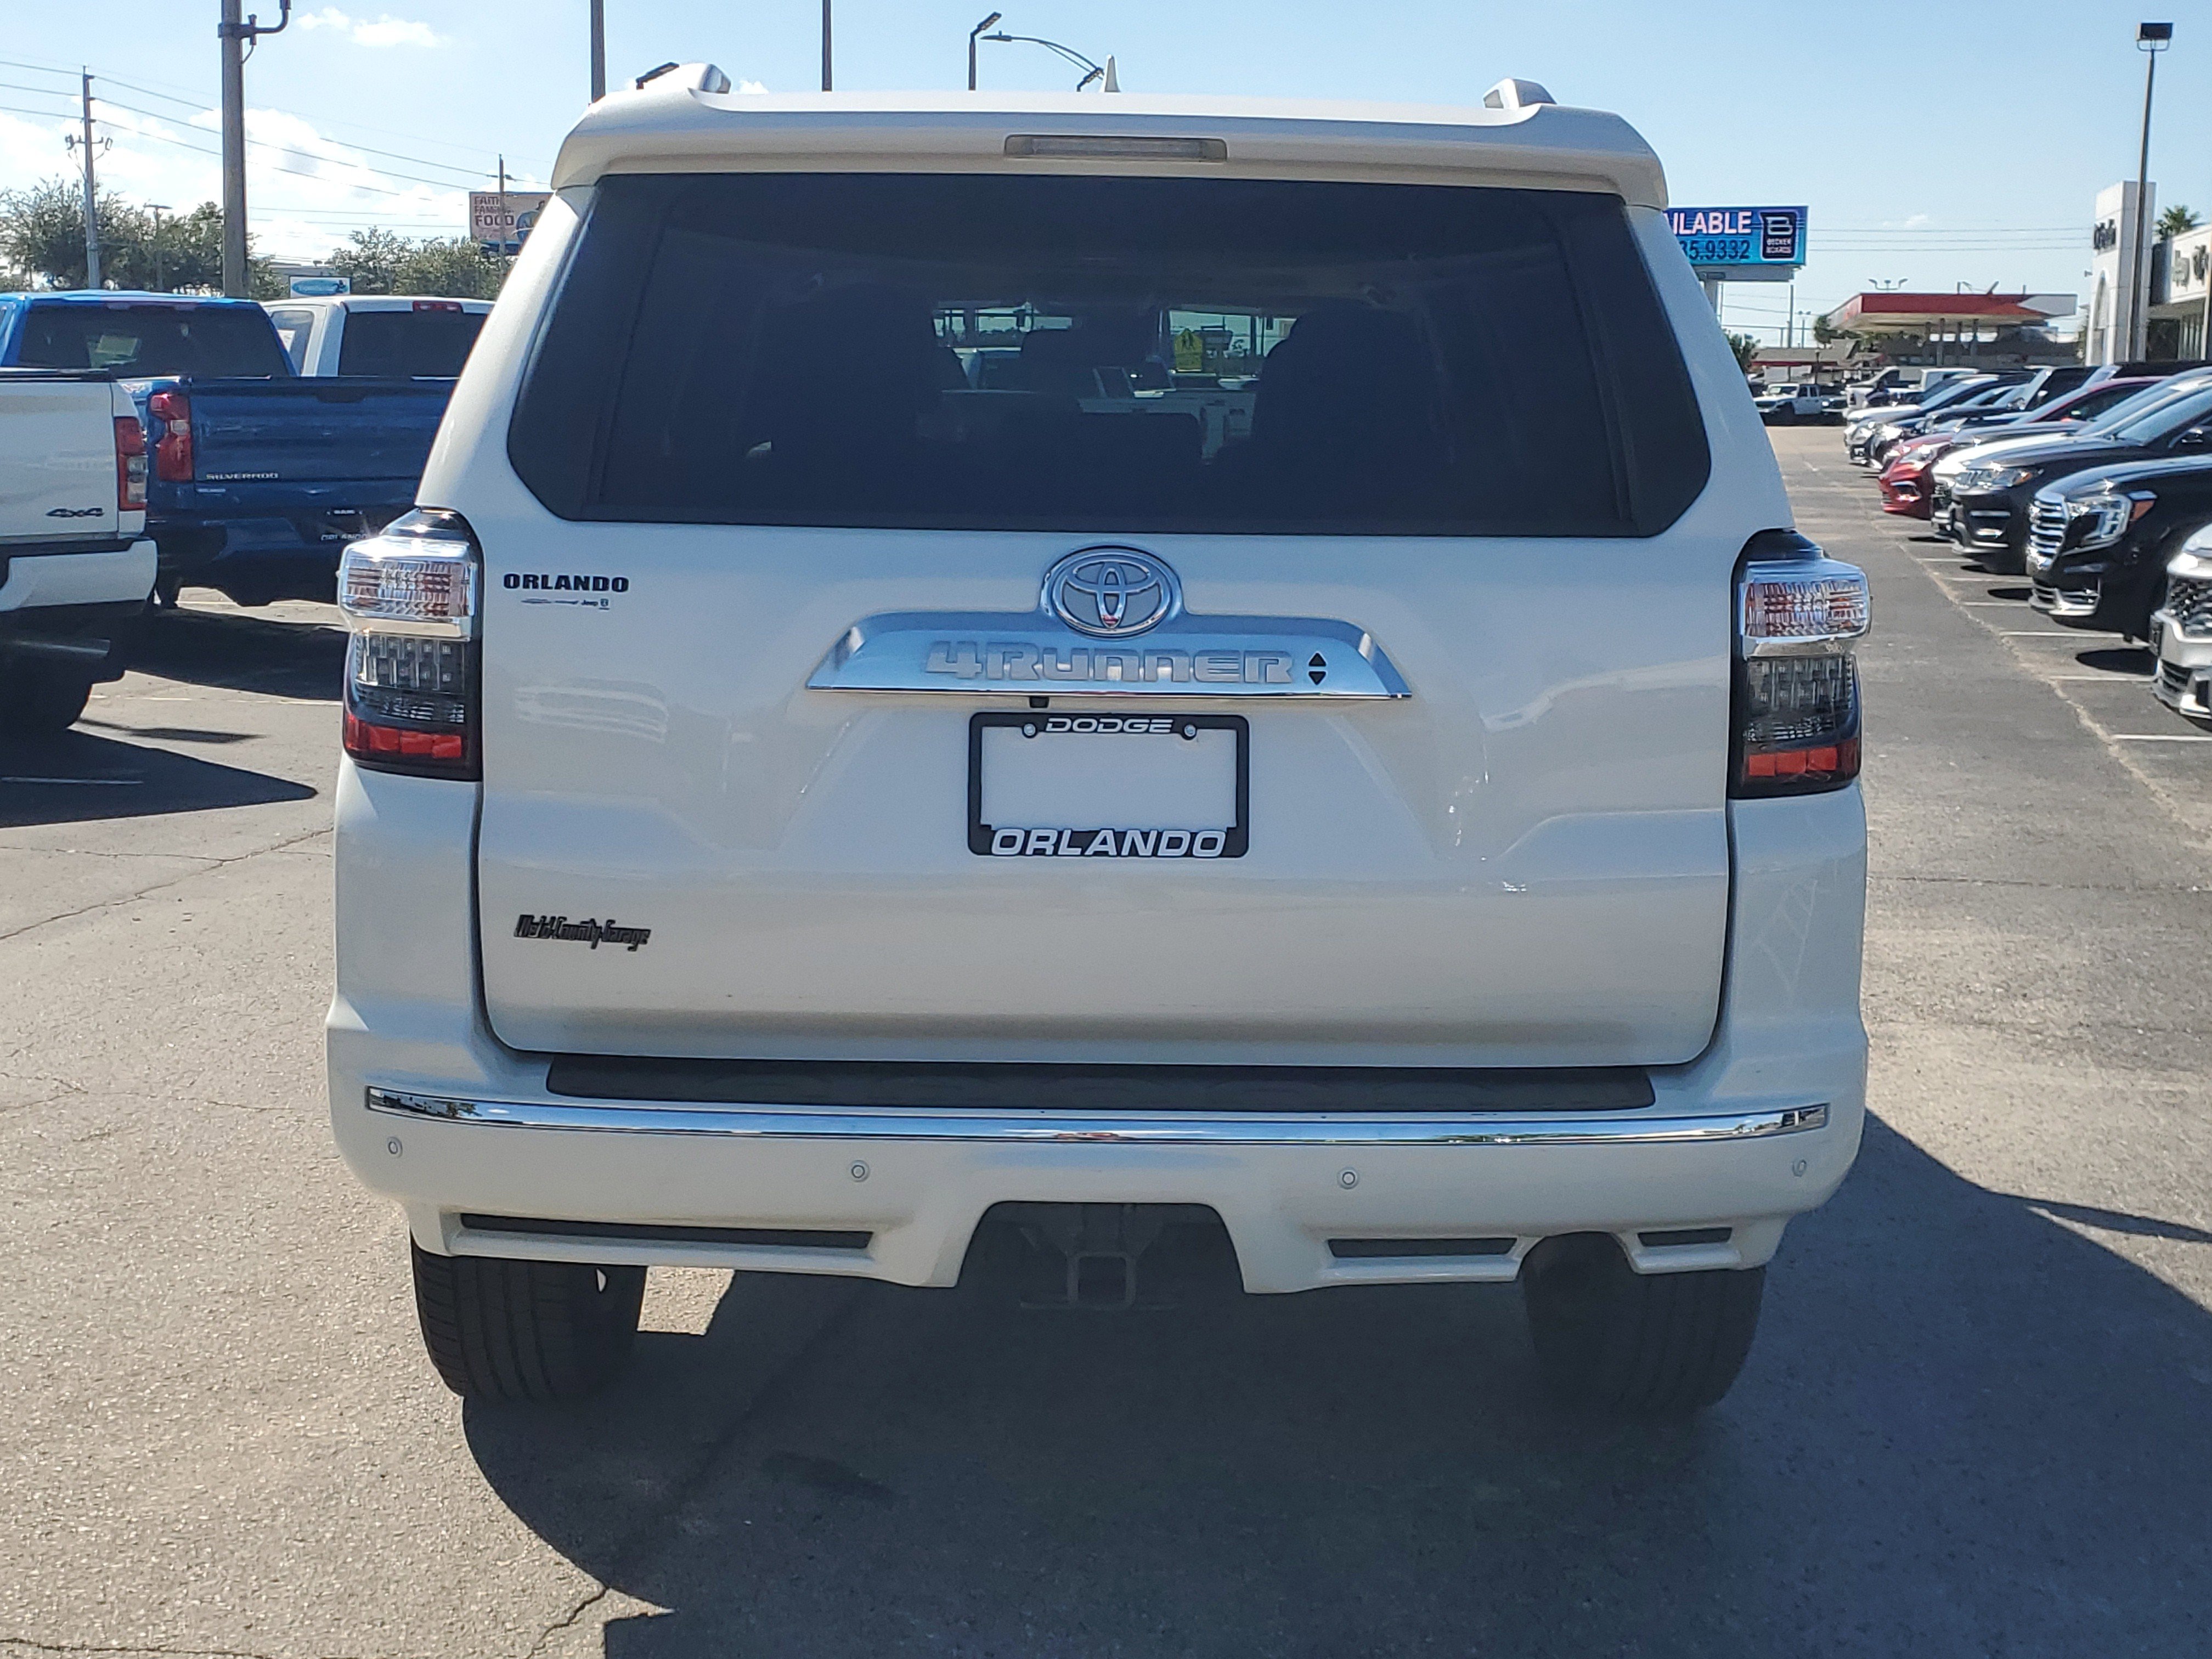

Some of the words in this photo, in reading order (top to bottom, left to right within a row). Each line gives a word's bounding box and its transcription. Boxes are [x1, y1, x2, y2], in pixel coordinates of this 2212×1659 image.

[475, 215, 514, 226] FOOD
[1664, 211, 1752, 235] ILABLE
[206, 472, 279, 481] SILVERADO
[503, 573, 629, 593] ORLANDO
[1045, 717, 1174, 733] DODGE
[991, 828, 1227, 857] ORLANDO
